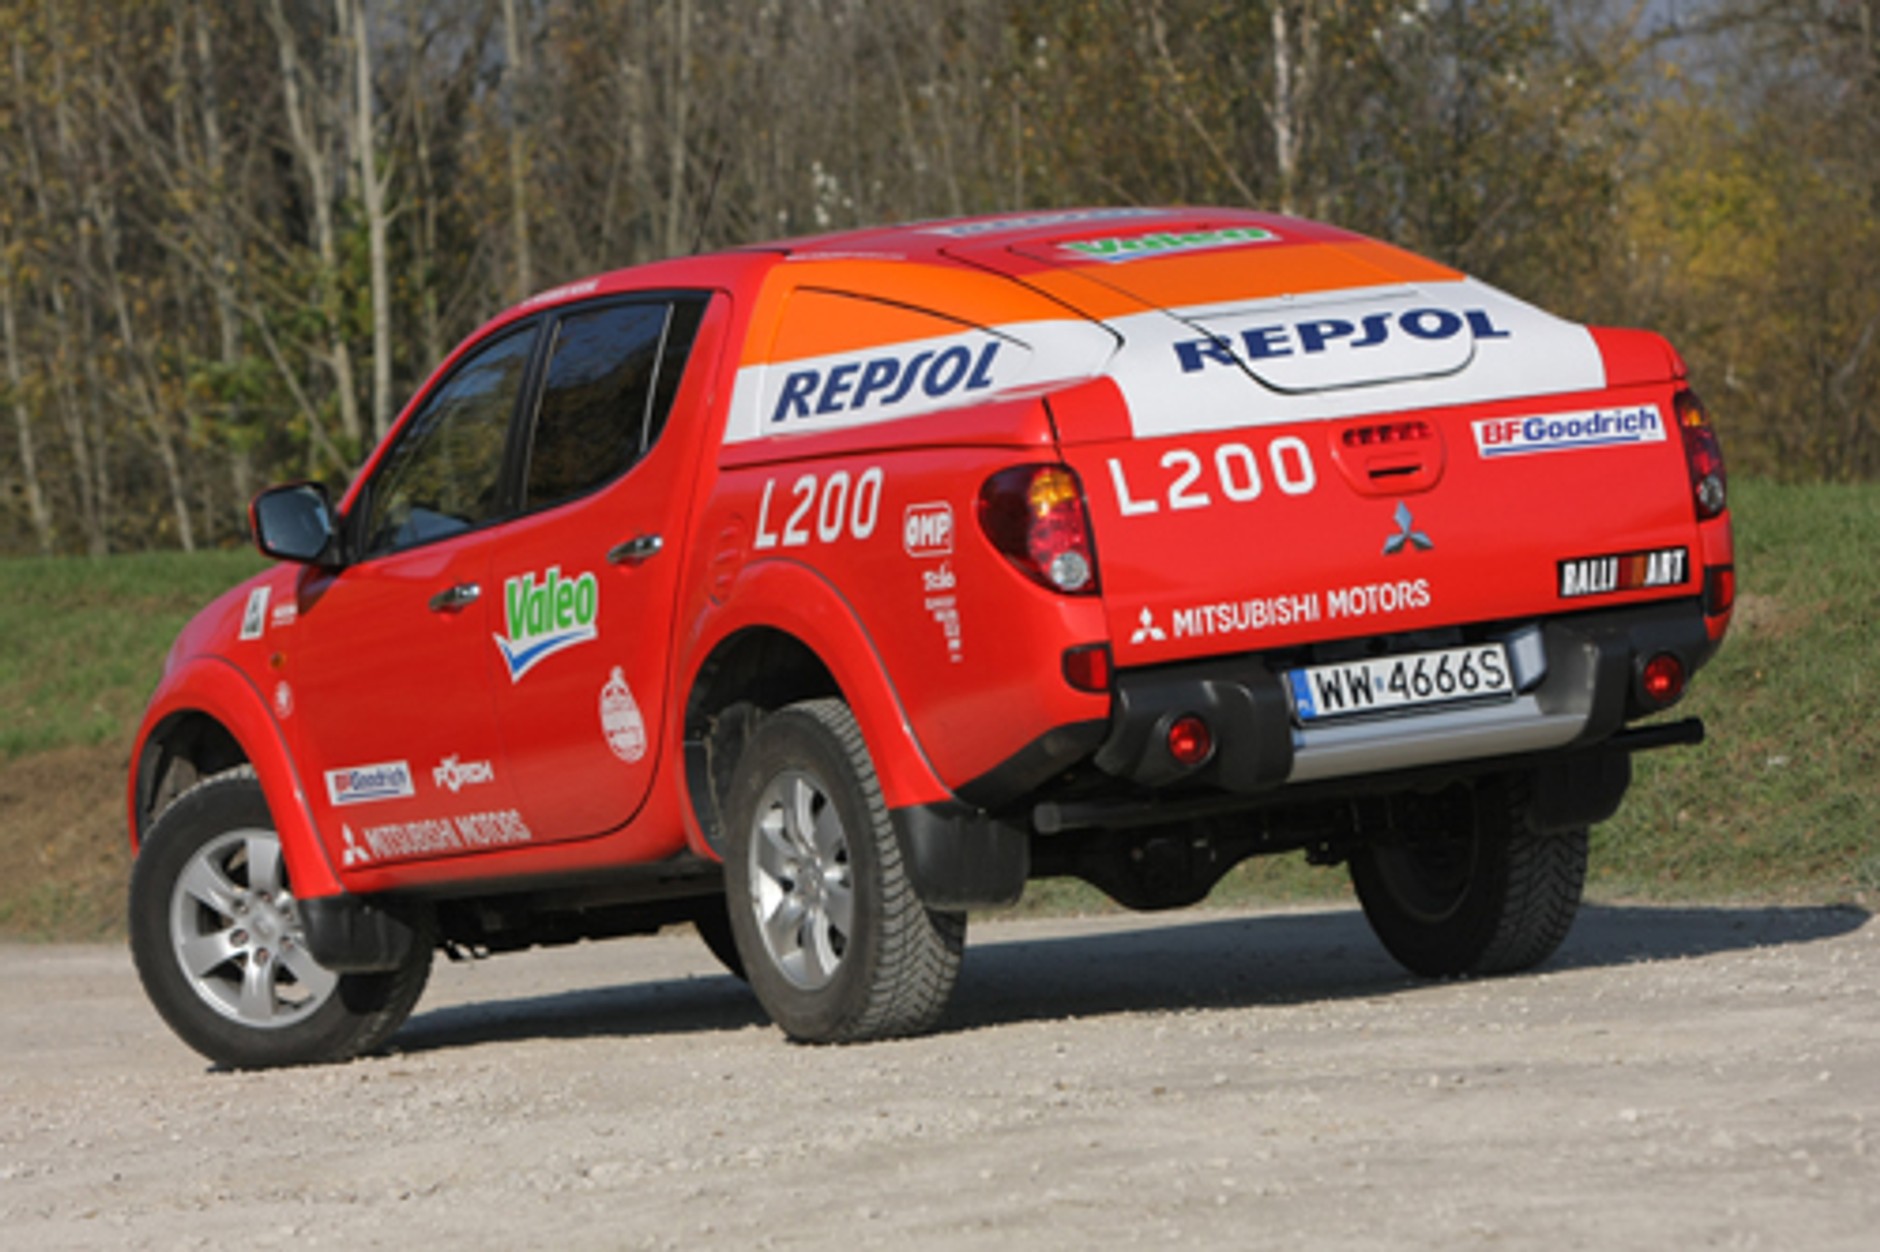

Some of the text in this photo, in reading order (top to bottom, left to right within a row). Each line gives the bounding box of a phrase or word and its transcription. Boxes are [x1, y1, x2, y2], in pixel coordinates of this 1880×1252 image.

[1064, 228, 1273, 254] Valeo
[1173, 308, 1511, 373] REPSOL
[770, 342, 1003, 422] REPSOL
[1482, 408, 1656, 444] BFGoodrich
[1107, 436, 1317, 516] L200
[753, 467, 884, 549] L200
[907, 512, 950, 546] OMP
[505, 567, 597, 640] Valeo
[1173, 579, 1431, 638] MITSUBISHI MOTORS
[1316, 650, 1505, 709] WW 4666S
[364, 817, 462, 858] MITSUBISHI
